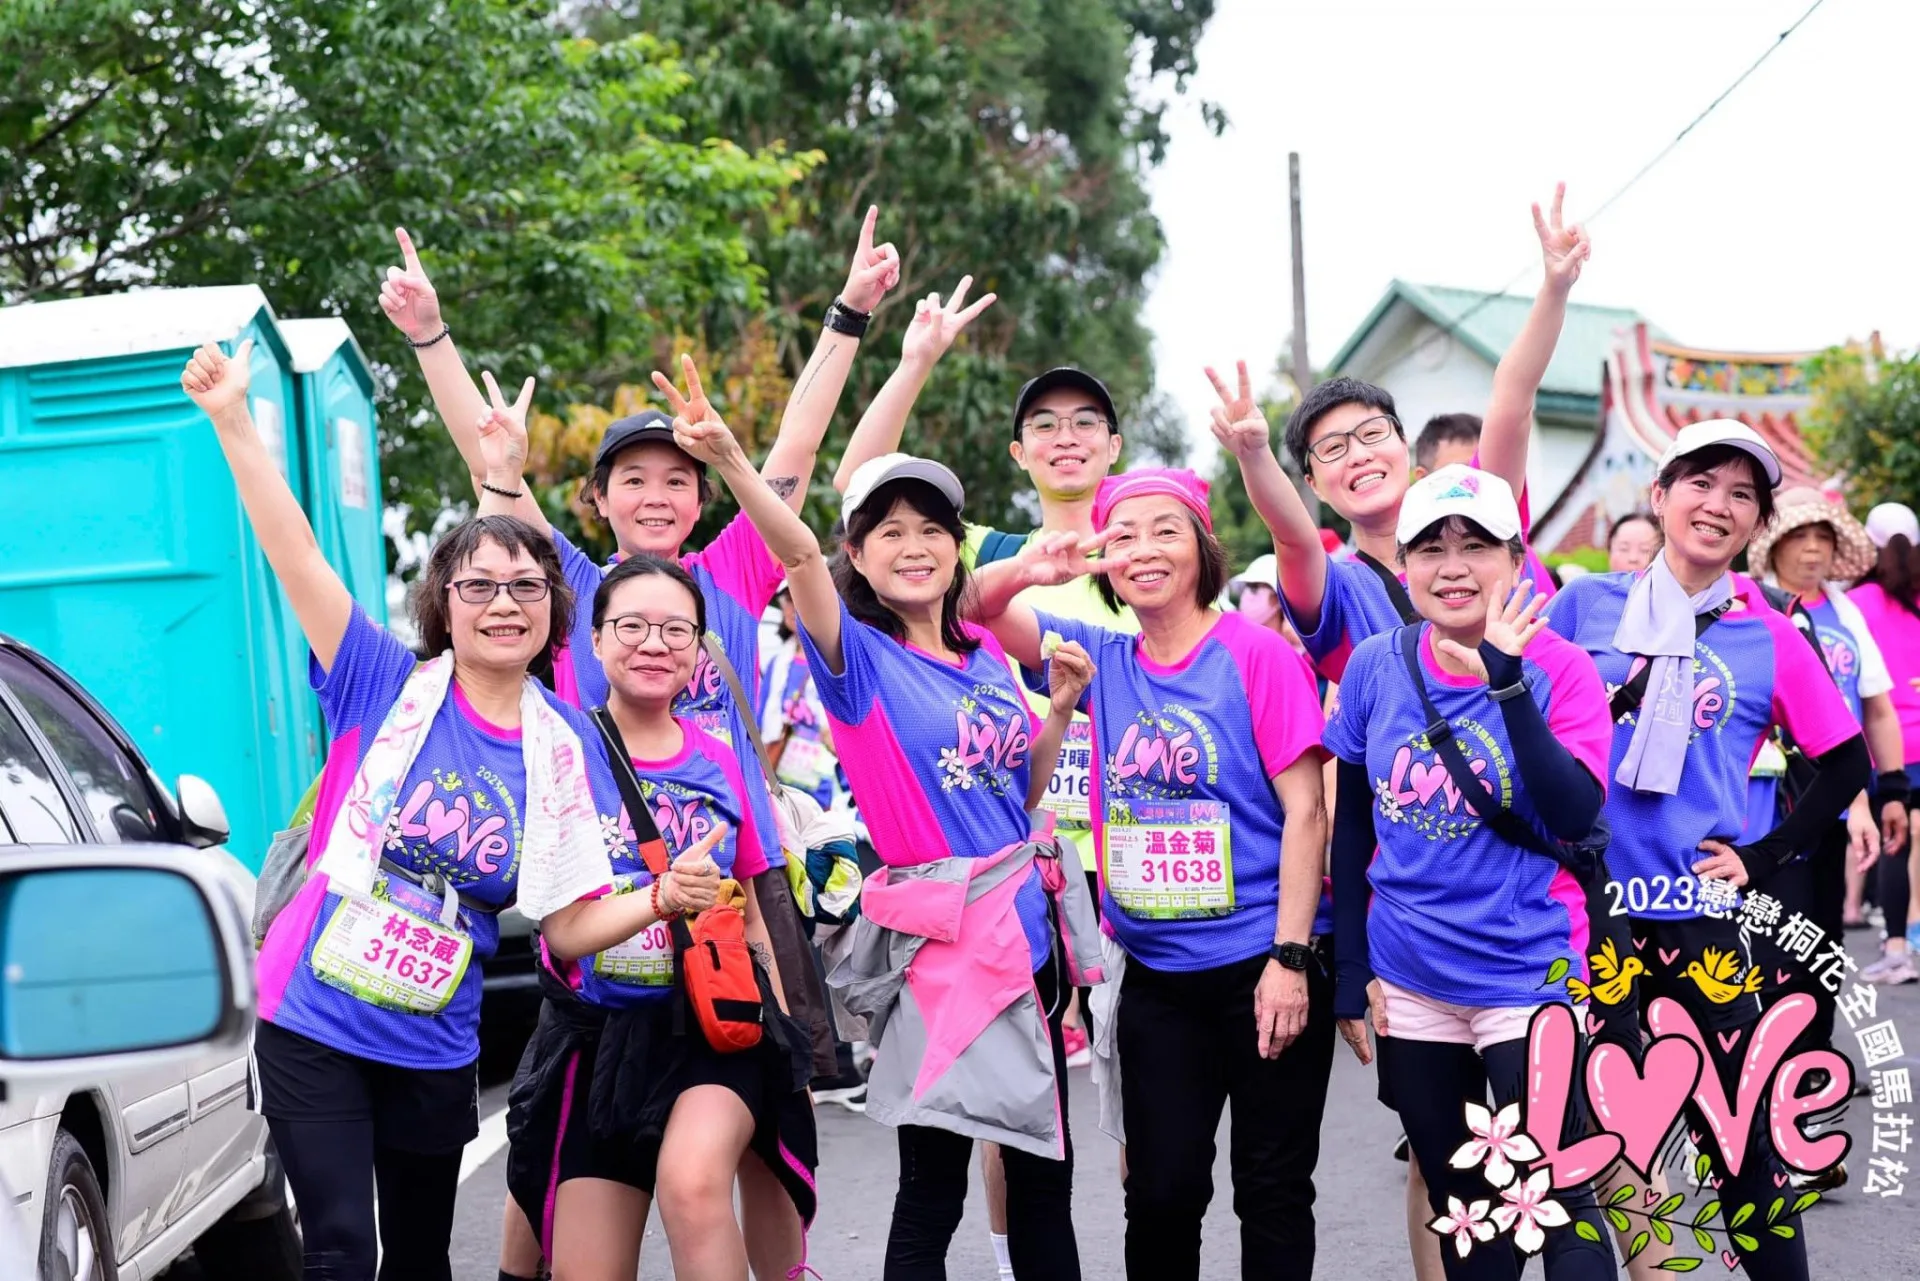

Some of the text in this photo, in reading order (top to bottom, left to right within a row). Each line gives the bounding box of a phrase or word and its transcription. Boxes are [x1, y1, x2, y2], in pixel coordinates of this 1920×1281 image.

[1144, 830, 1216, 855] 溫金菊
[1141, 859, 1222, 883] 31638
[363, 938, 453, 990] 31637
